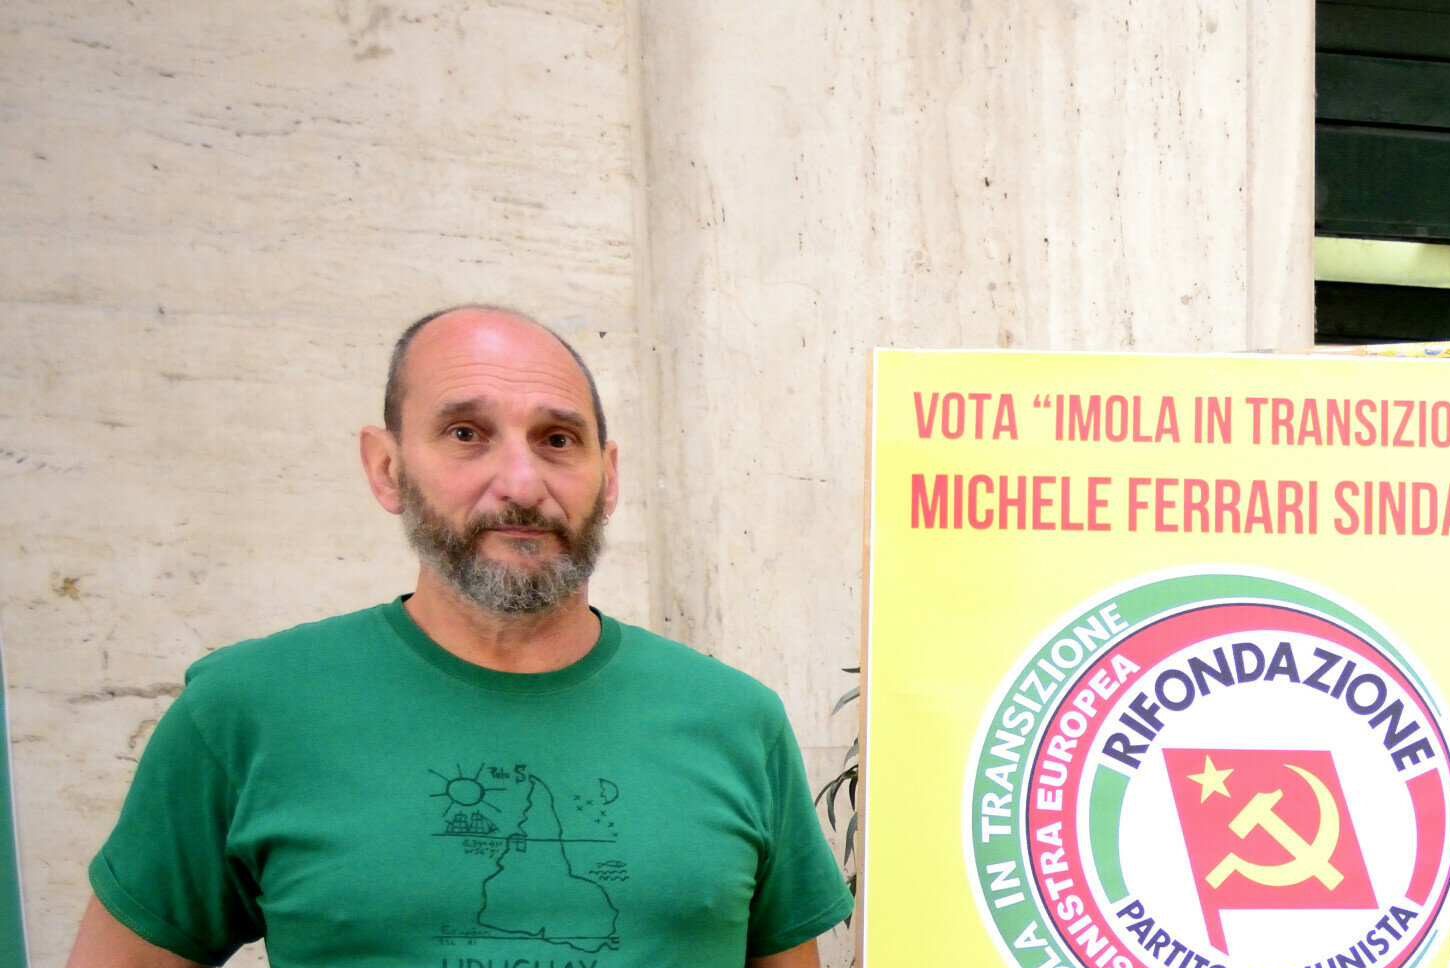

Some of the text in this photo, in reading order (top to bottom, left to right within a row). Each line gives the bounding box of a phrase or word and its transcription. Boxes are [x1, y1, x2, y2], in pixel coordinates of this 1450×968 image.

[913, 391, 1018, 441] VOTA
[1033, 394, 1180, 443] “IMOLA
[1194, 396, 1232, 444] IN
[910, 473, 1112, 532] MICHELE
[1128, 477, 1318, 536] FERRARI
[981, 602, 1129, 843] TRANSIZIONE
[1036, 653, 1142, 811] EUROPEA
[1101, 641, 1436, 772] RIFONDAZIONE
[986, 860, 1025, 909] IN
